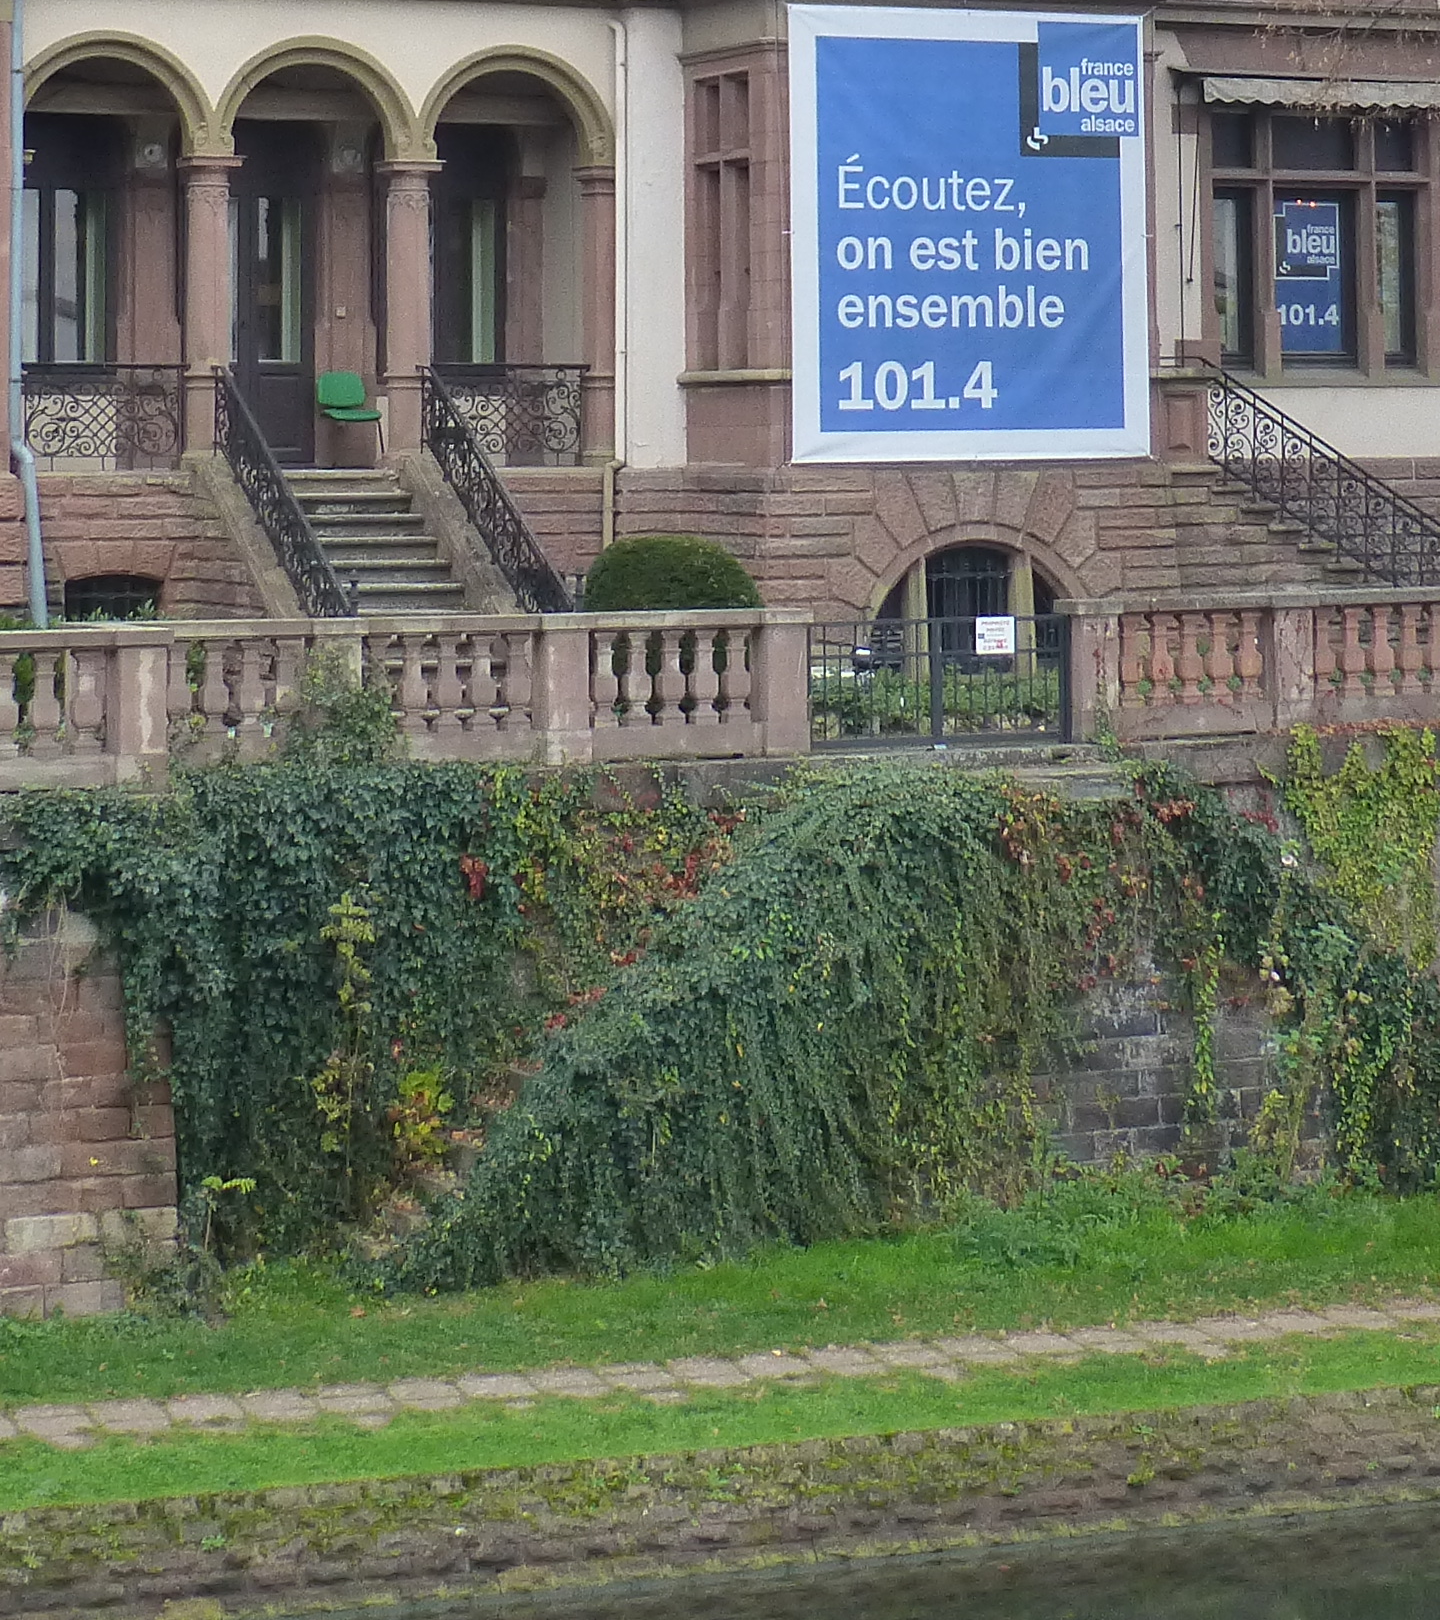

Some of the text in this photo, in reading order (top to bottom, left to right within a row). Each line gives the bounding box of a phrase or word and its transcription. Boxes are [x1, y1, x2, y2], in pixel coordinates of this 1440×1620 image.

[1080, 58, 1135, 77] france
[1041, 66, 1135, 115] bleu
[1080, 116, 1135, 133] alsace
[837, 154, 1027, 218] Écoutez,
[836, 227, 1089, 271] on est bien
[1286, 228, 1335, 254] bleu
[837, 285, 1065, 329] ensemble
[1276, 303, 1340, 326] 101.4
[838, 360, 998, 411] 101.4
